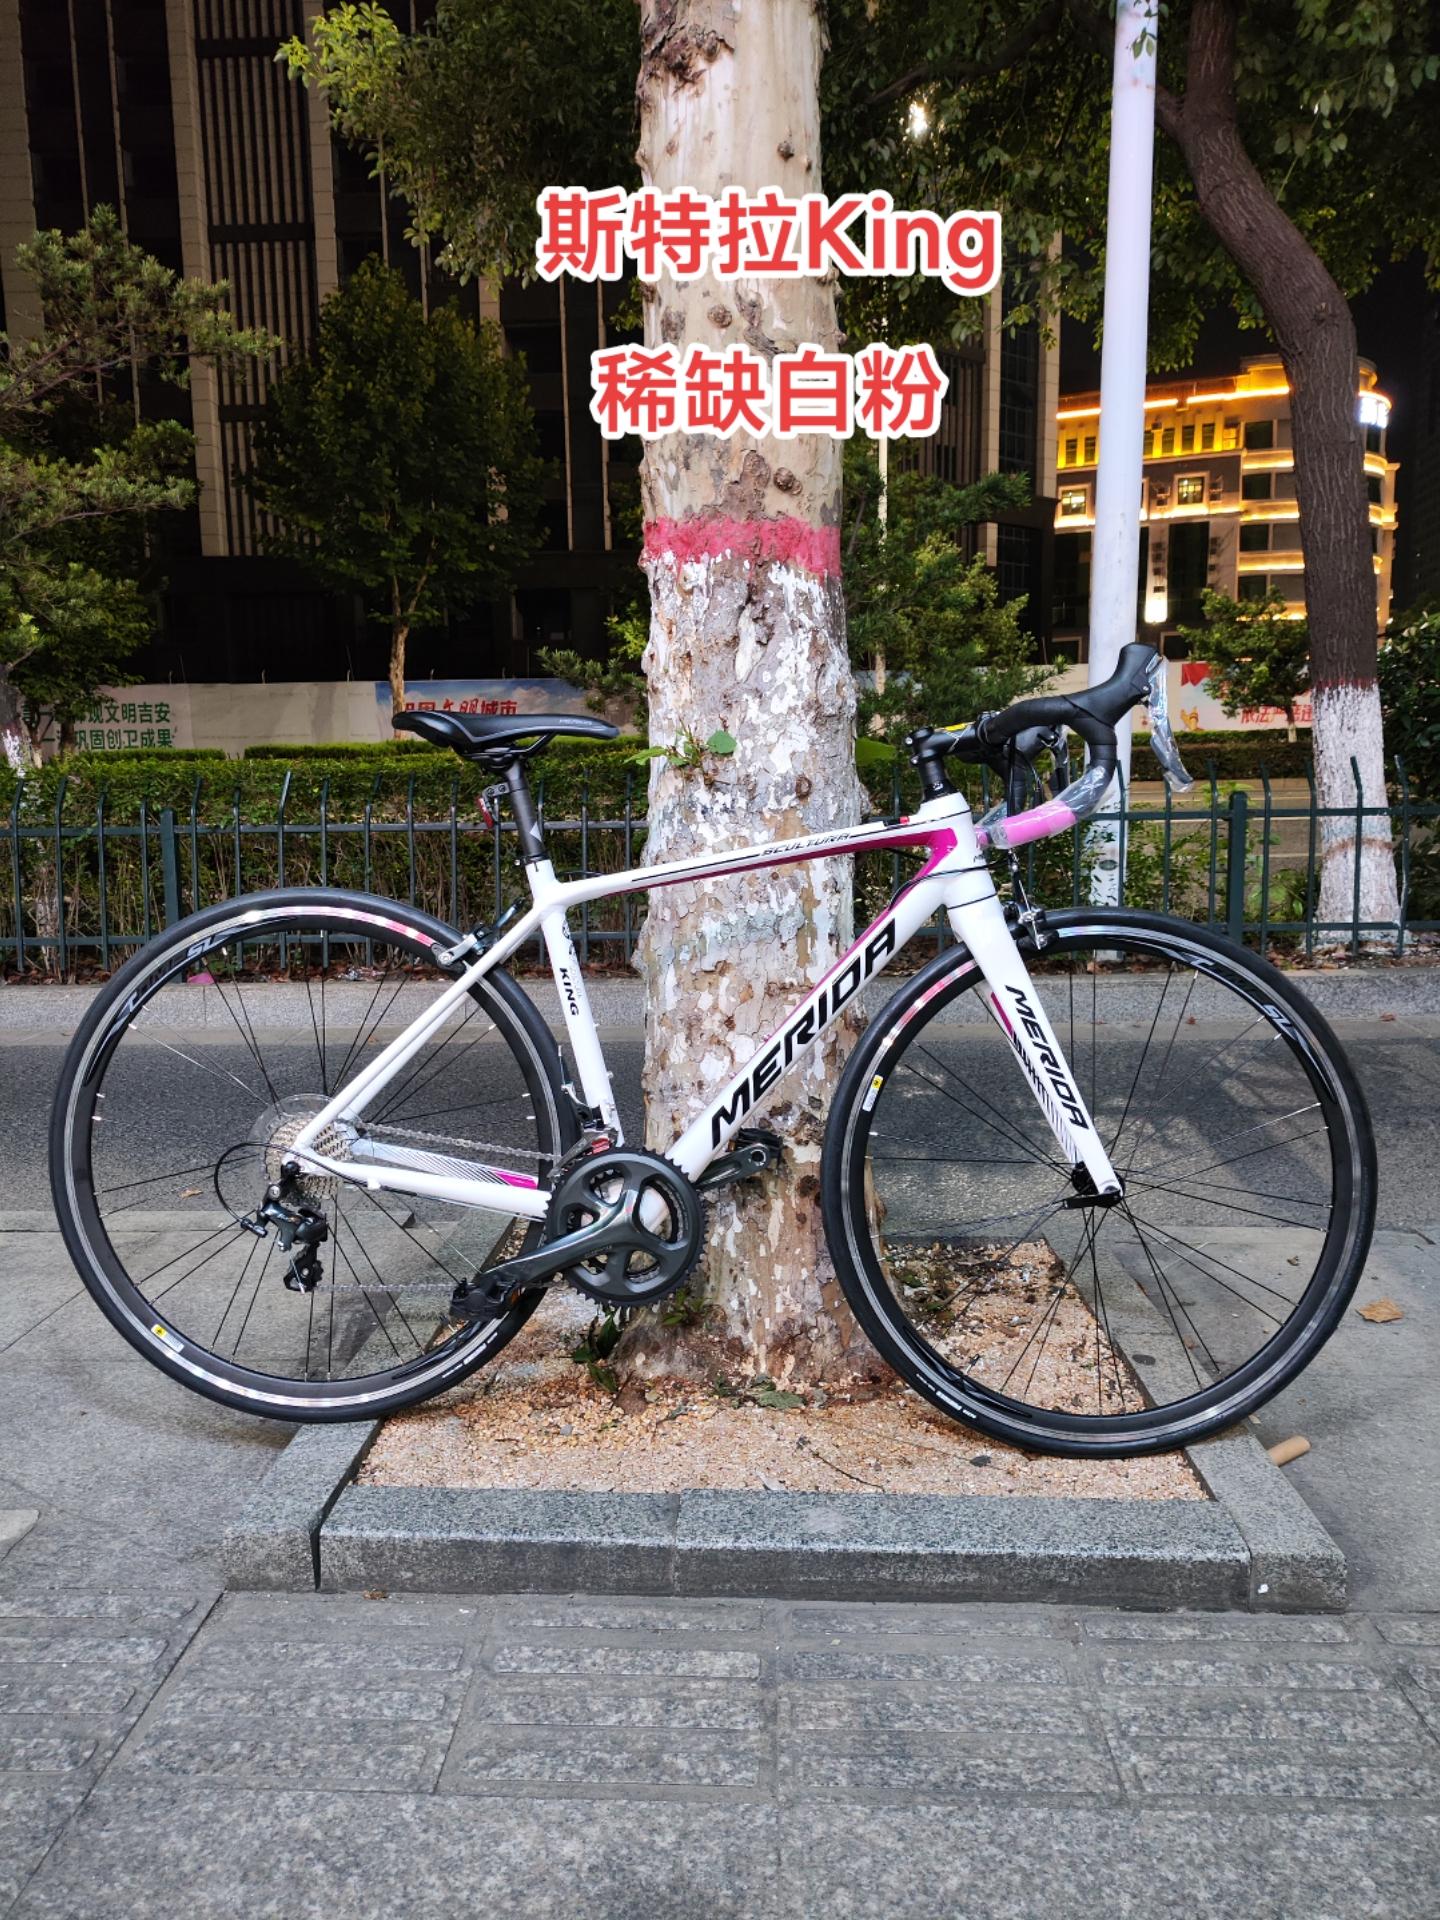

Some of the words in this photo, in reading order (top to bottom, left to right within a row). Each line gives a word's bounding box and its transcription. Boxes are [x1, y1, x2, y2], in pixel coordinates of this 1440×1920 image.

[559, 967, 580, 1016] KING
[711, 917, 897, 1150] MERIDA
[1004, 984, 1090, 1130] MERIDA
